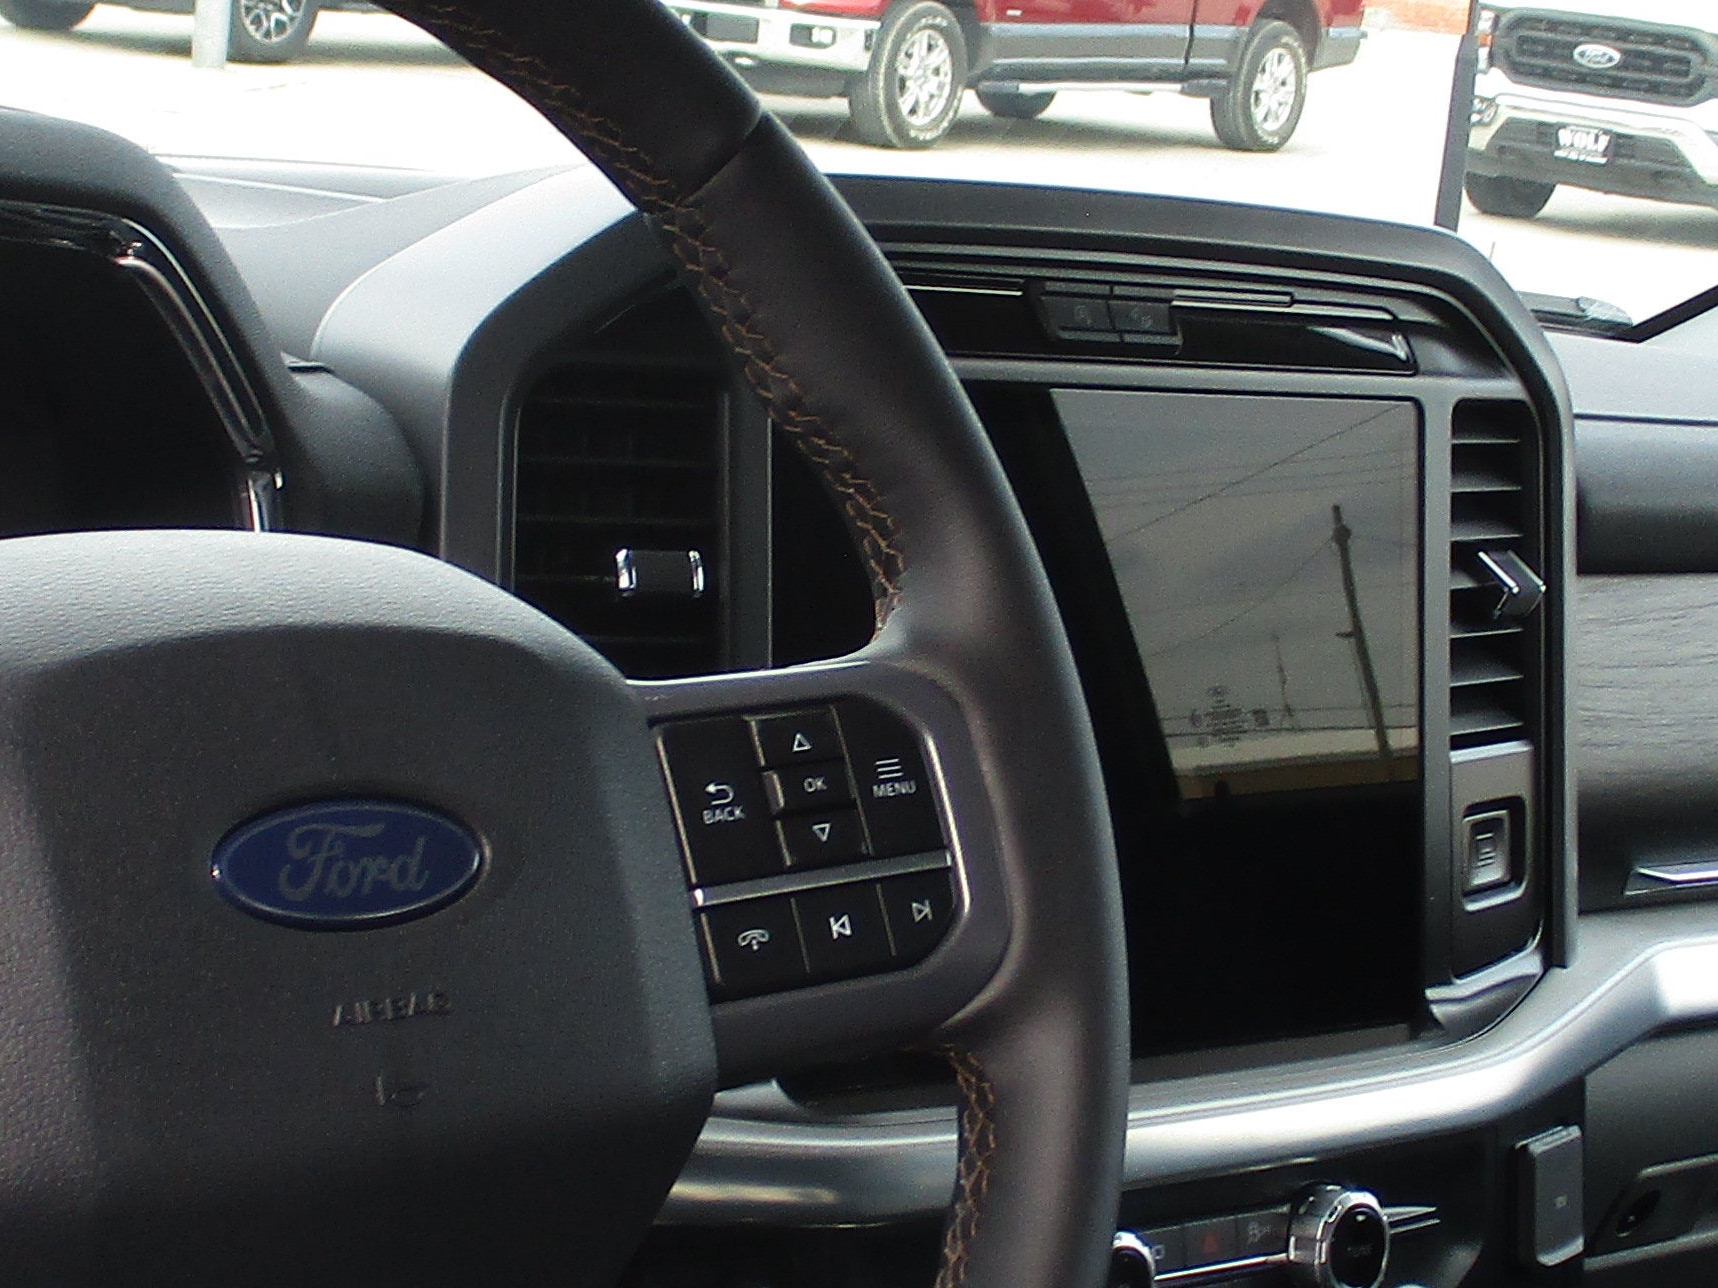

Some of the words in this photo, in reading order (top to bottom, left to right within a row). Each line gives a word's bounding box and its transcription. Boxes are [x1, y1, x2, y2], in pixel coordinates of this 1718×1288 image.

[804, 777, 828, 793] OK
[872, 780, 917, 799] MENU
[702, 807, 745, 825] BACK
[277, 822, 431, 902] Ford
